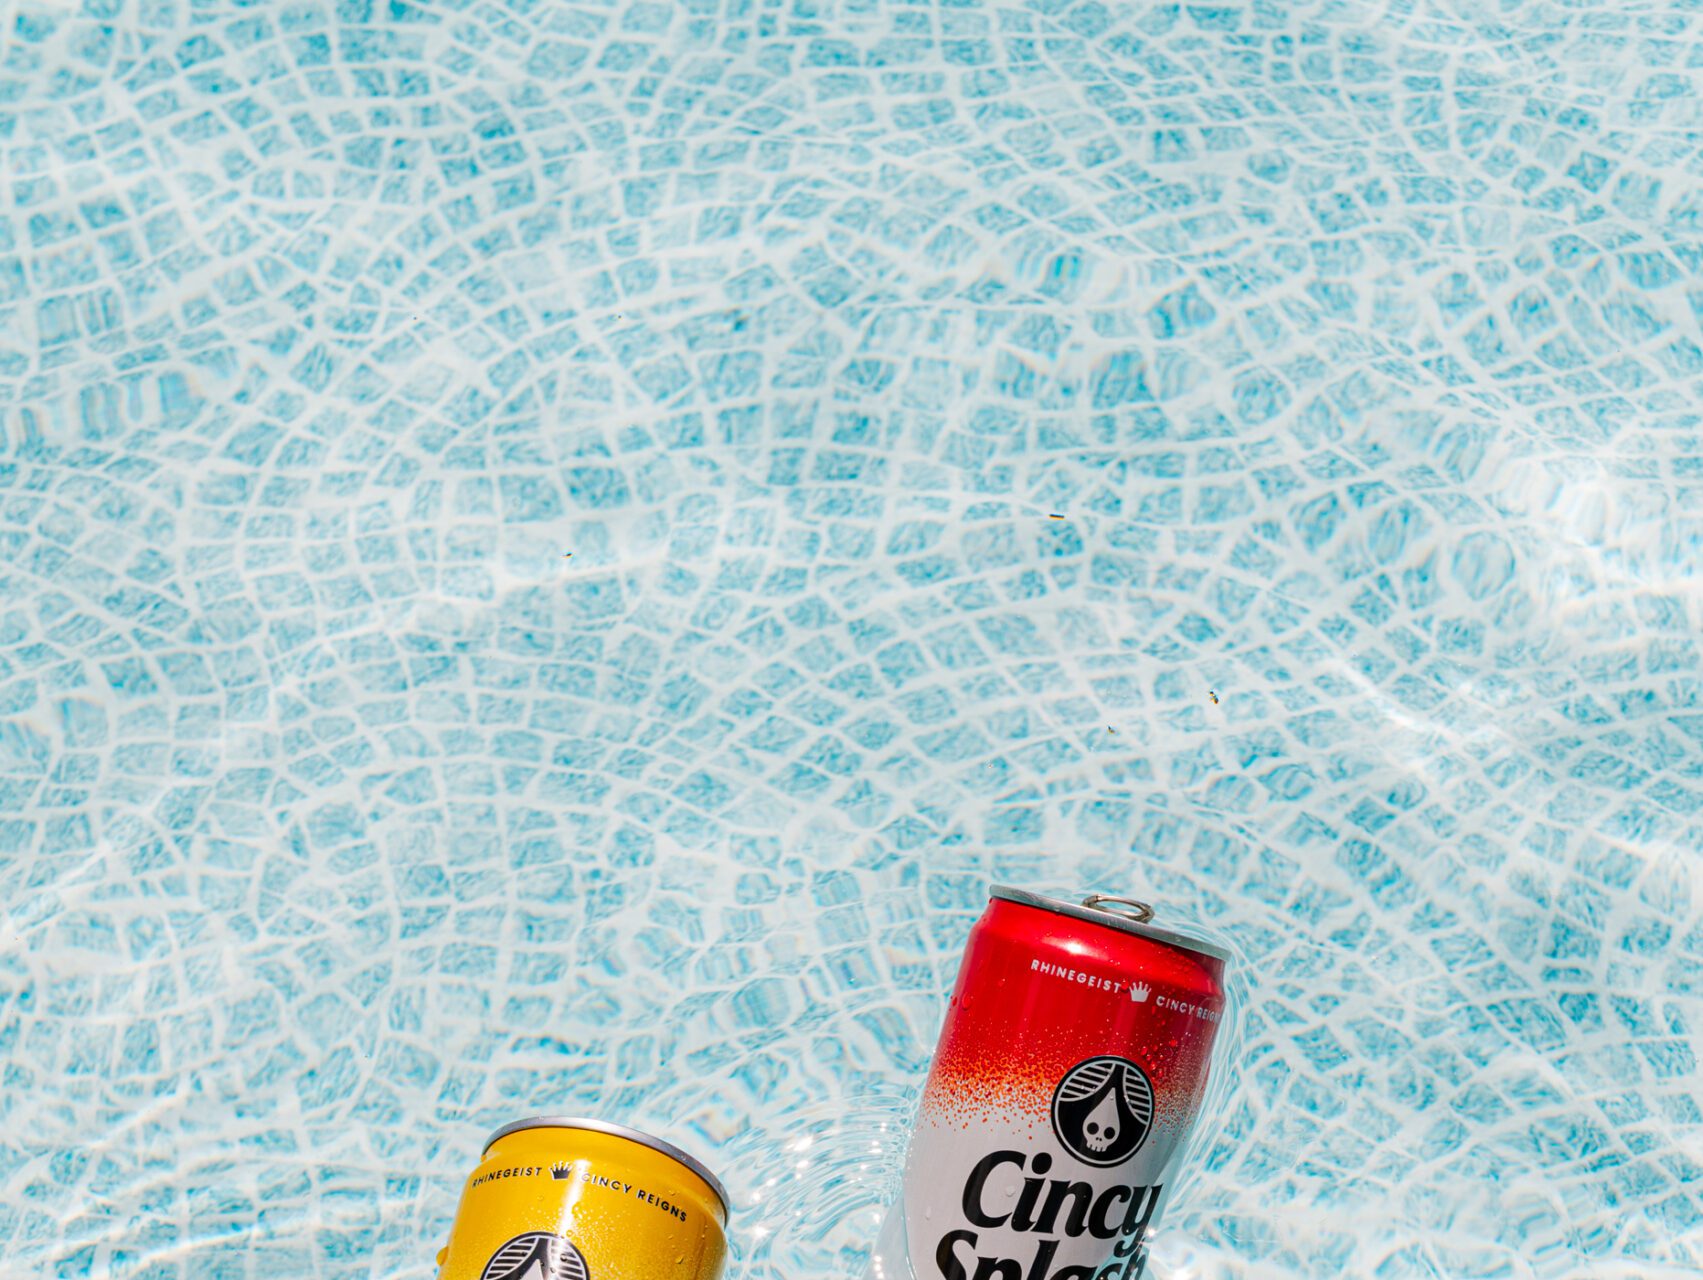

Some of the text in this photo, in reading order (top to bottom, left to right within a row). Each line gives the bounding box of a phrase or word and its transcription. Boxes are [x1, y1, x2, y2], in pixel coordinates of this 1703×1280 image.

[1031, 959, 1121, 993] RHINEGEIST
[1156, 995, 1196, 1015] CINCY
[472, 1167, 688, 1223] RHINEGEIST CINCY REIGNS
[962, 1150, 1163, 1258] Cincy
